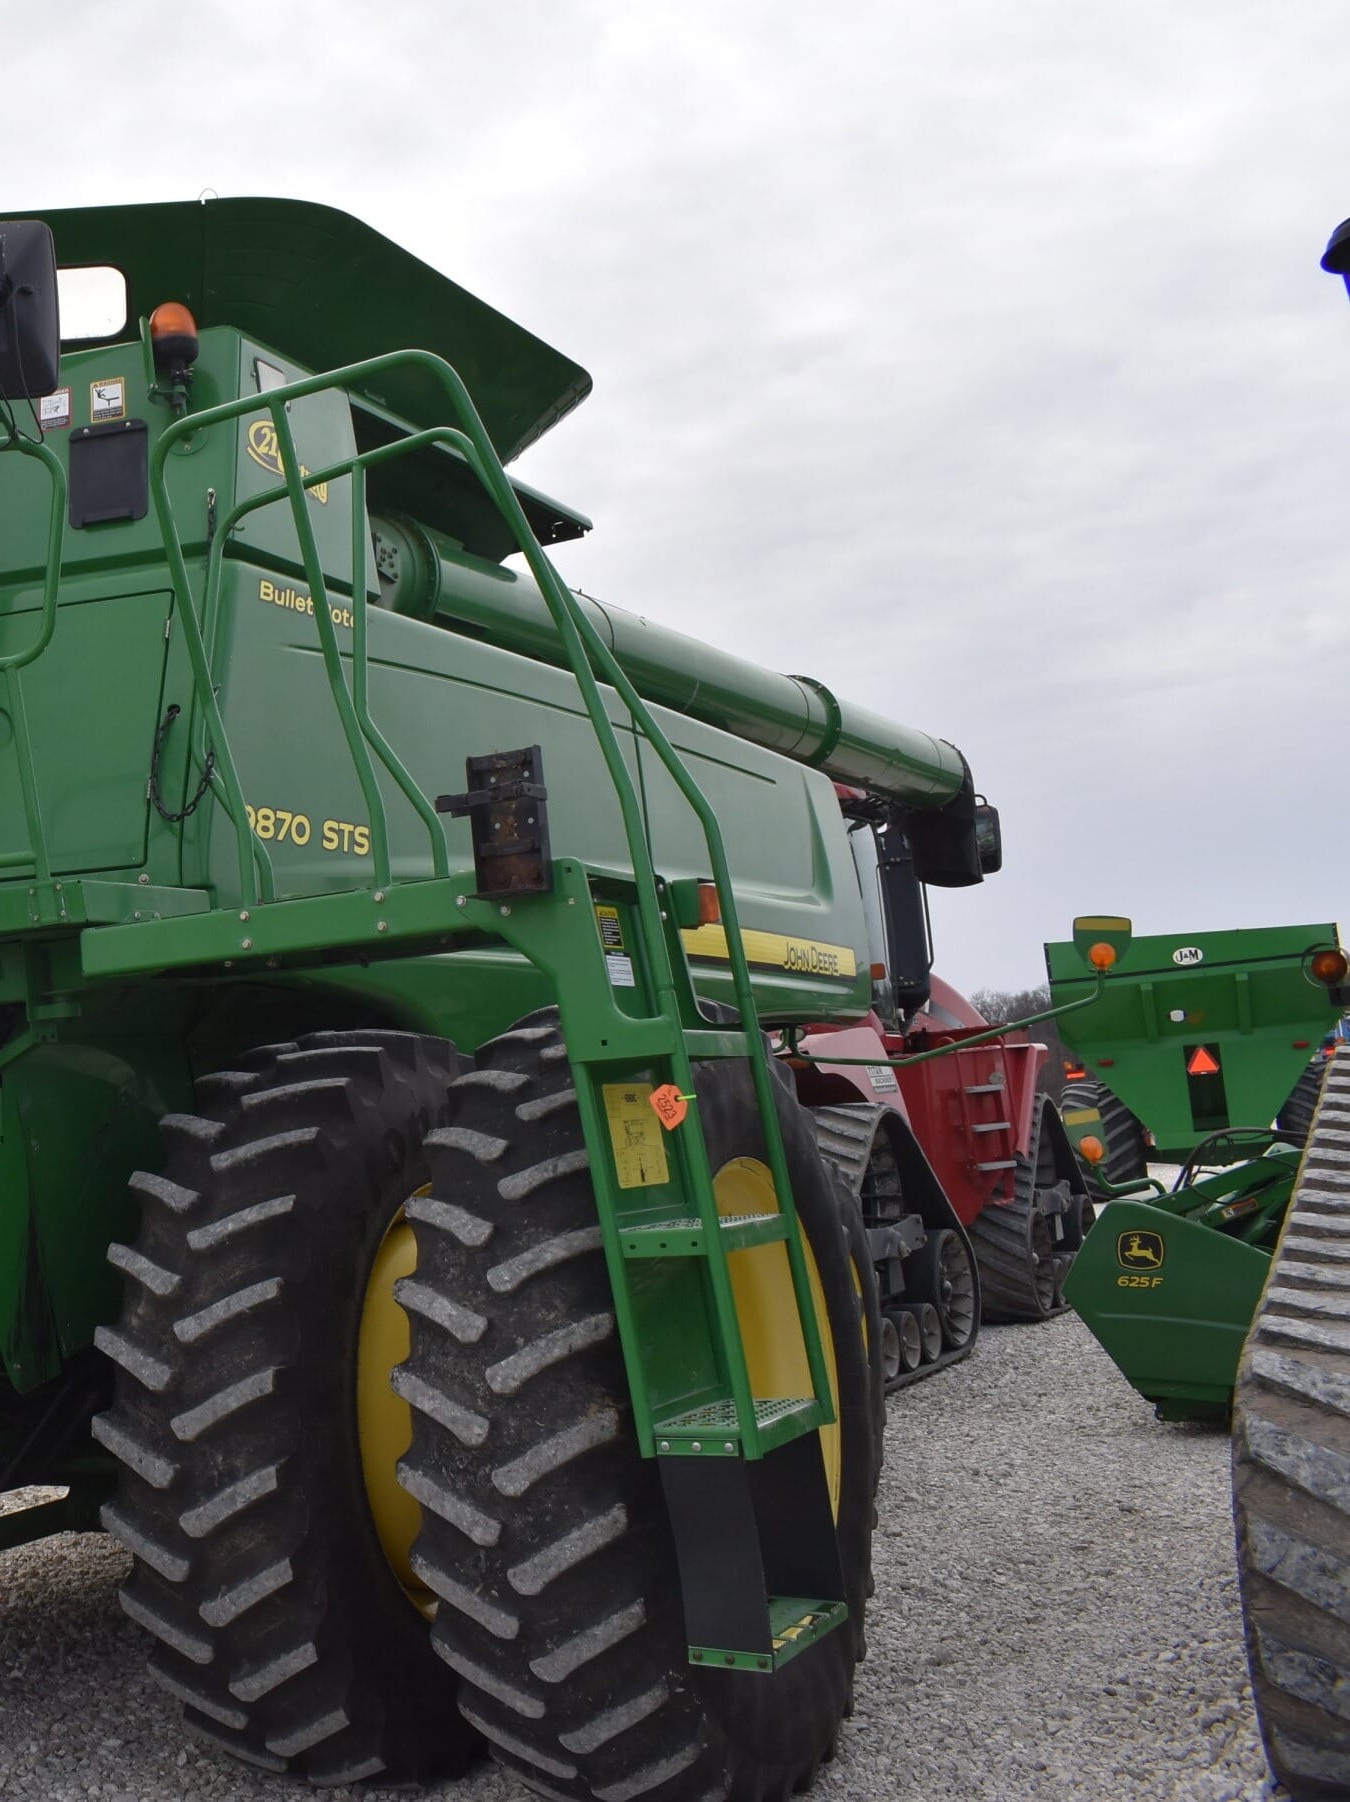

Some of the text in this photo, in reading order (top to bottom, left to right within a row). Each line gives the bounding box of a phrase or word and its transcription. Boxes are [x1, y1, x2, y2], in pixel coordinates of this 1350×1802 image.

[259, 579, 314, 616] Bullet
[322, 819, 370, 855] STS
[1176, 949, 1200, 963] J&M
